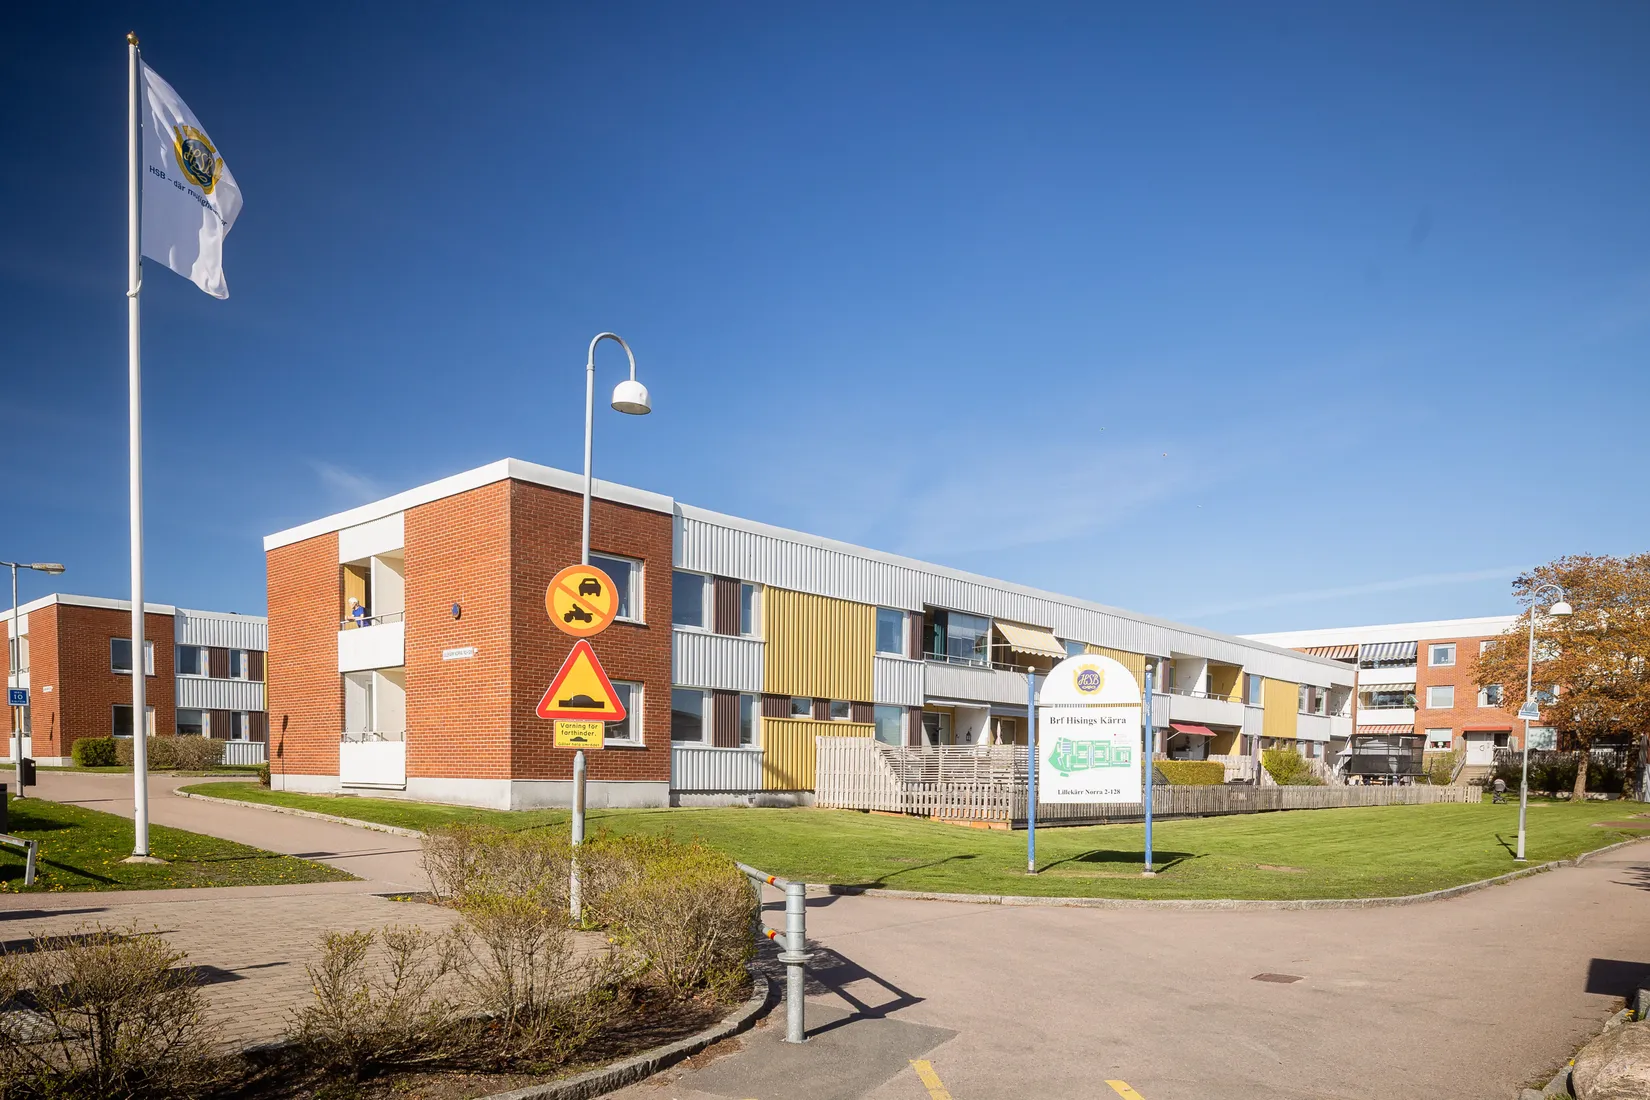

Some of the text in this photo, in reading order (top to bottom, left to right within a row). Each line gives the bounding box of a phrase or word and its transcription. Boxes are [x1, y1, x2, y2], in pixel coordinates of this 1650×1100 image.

[149, 165, 166, 180] HSB
[173, 180, 185, 192] där
[1078, 673, 1100, 686] HSB
[1050, 716, 1127, 726] Brf Hisings Kärra
